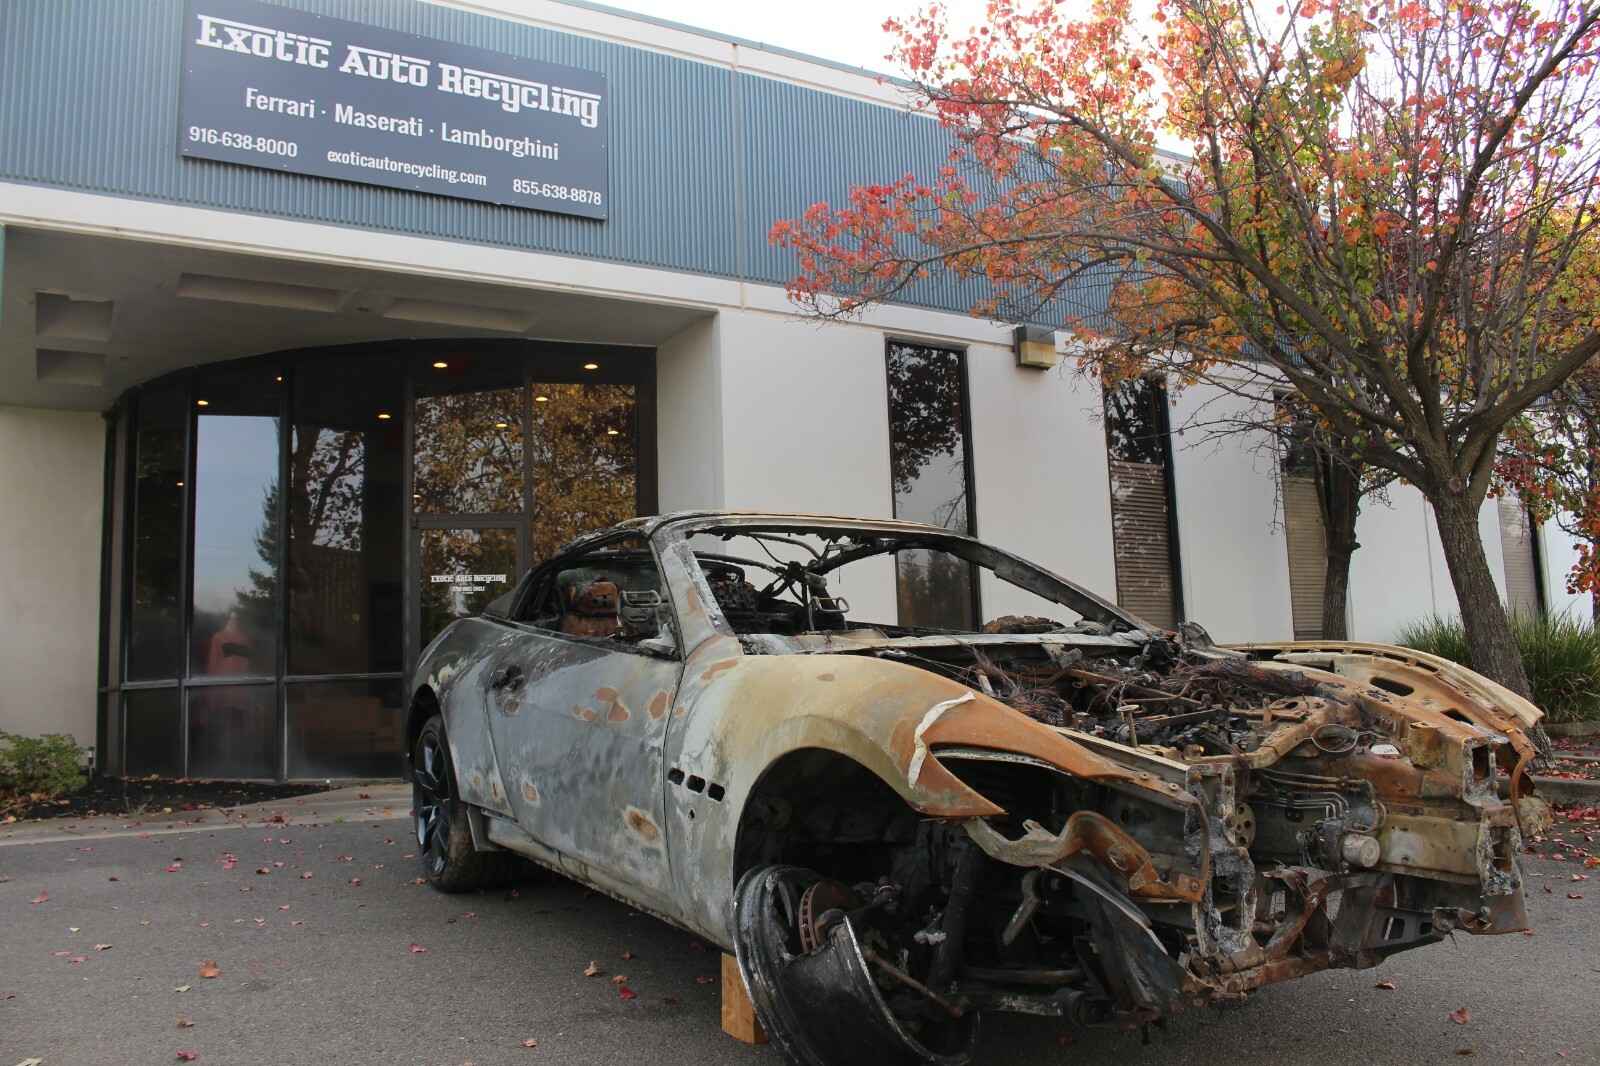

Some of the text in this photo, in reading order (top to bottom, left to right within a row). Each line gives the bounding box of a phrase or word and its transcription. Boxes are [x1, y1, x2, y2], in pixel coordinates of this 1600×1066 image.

[196, 14, 601, 128] Exotic Auto Recycling
[189, 126, 298, 157] 916-638-8000
[246, 87, 559, 160] Ferrari Maserati Lamborghini
[327, 150, 487, 186] exoticautorecycling.com
[513, 178, 602, 205] 855-638-8878
